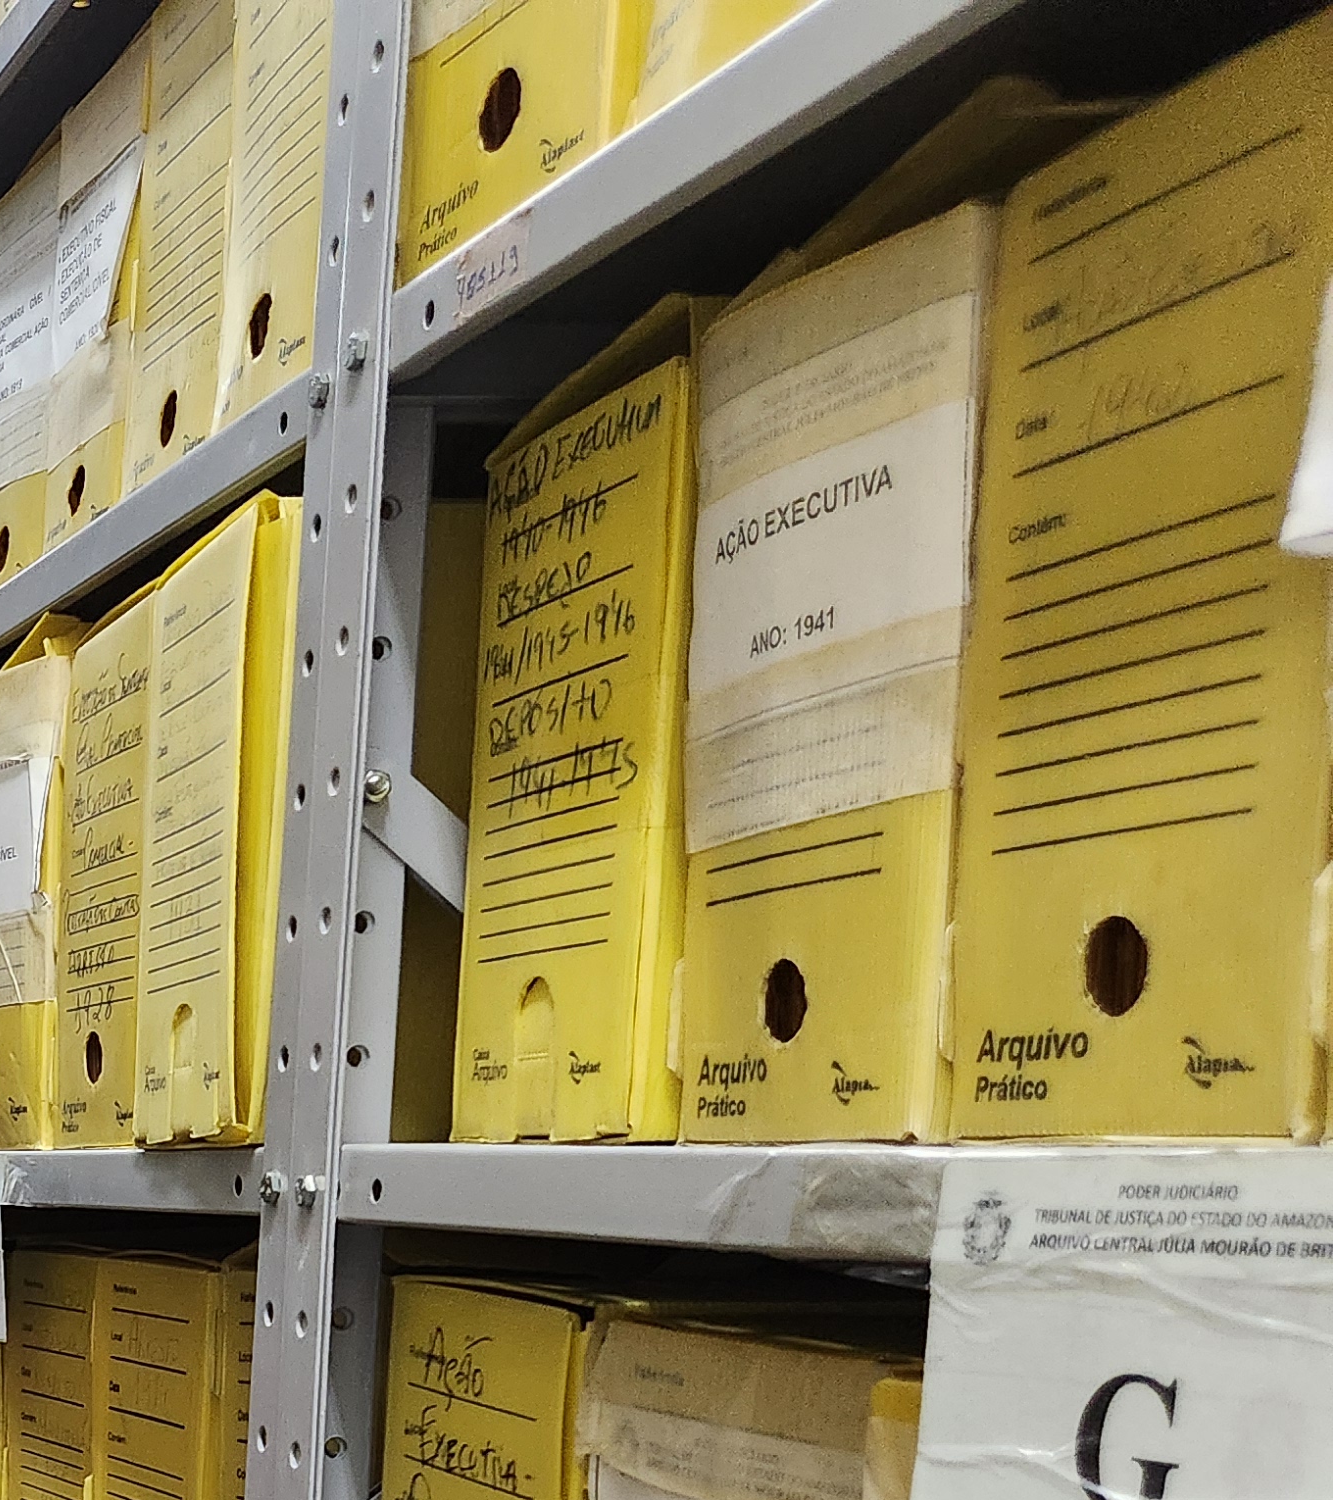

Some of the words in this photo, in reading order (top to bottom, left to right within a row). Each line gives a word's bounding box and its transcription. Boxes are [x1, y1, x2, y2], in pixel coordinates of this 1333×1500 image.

[541, 130, 585, 170] Alaplast
[418, 178, 479, 236] Arquivo
[417, 224, 458, 262] Prático
[714, 522, 759, 565] AÇÃO
[764, 463, 892, 539] EXECUTIVA
[749, 624, 788, 660] ANO:
[794, 606, 836, 642] 1941
[976, 1028, 1090, 1071] Arquivo
[471, 1060, 508, 1082] Arquivo
[697, 1055, 767, 1089] Arquivo
[974, 1076, 1049, 1104] Prático
[697, 1097, 747, 1120] Prático
[1118, 1183, 1161, 1200] PODER
[1164, 1181, 1239, 1202] JUDICIÁRIO
[1034, 1209, 1090, 1226] TRIBUNAL
[1092, 1210, 1112, 1226] DE
[1114, 1209, 1164, 1228] JUSTIÇA
[1167, 1211, 1185, 1227] DO
[1187, 1211, 1242, 1228] ESTADO
[1246, 1212, 1267, 1228] DO
[1271, 1213, 1333, 1229] AMAZON
[1029, 1234, 1089, 1251] ARQUIVO
[1093, 1235, 1155, 1253] CENTRAL
[1158, 1233, 1196, 1255] JÚLIA
[1201, 1236, 1272, 1258] MOURÃO
[1275, 1242, 1298, 1258] DE
[1300, 1242, 1333, 1260] BRIT
